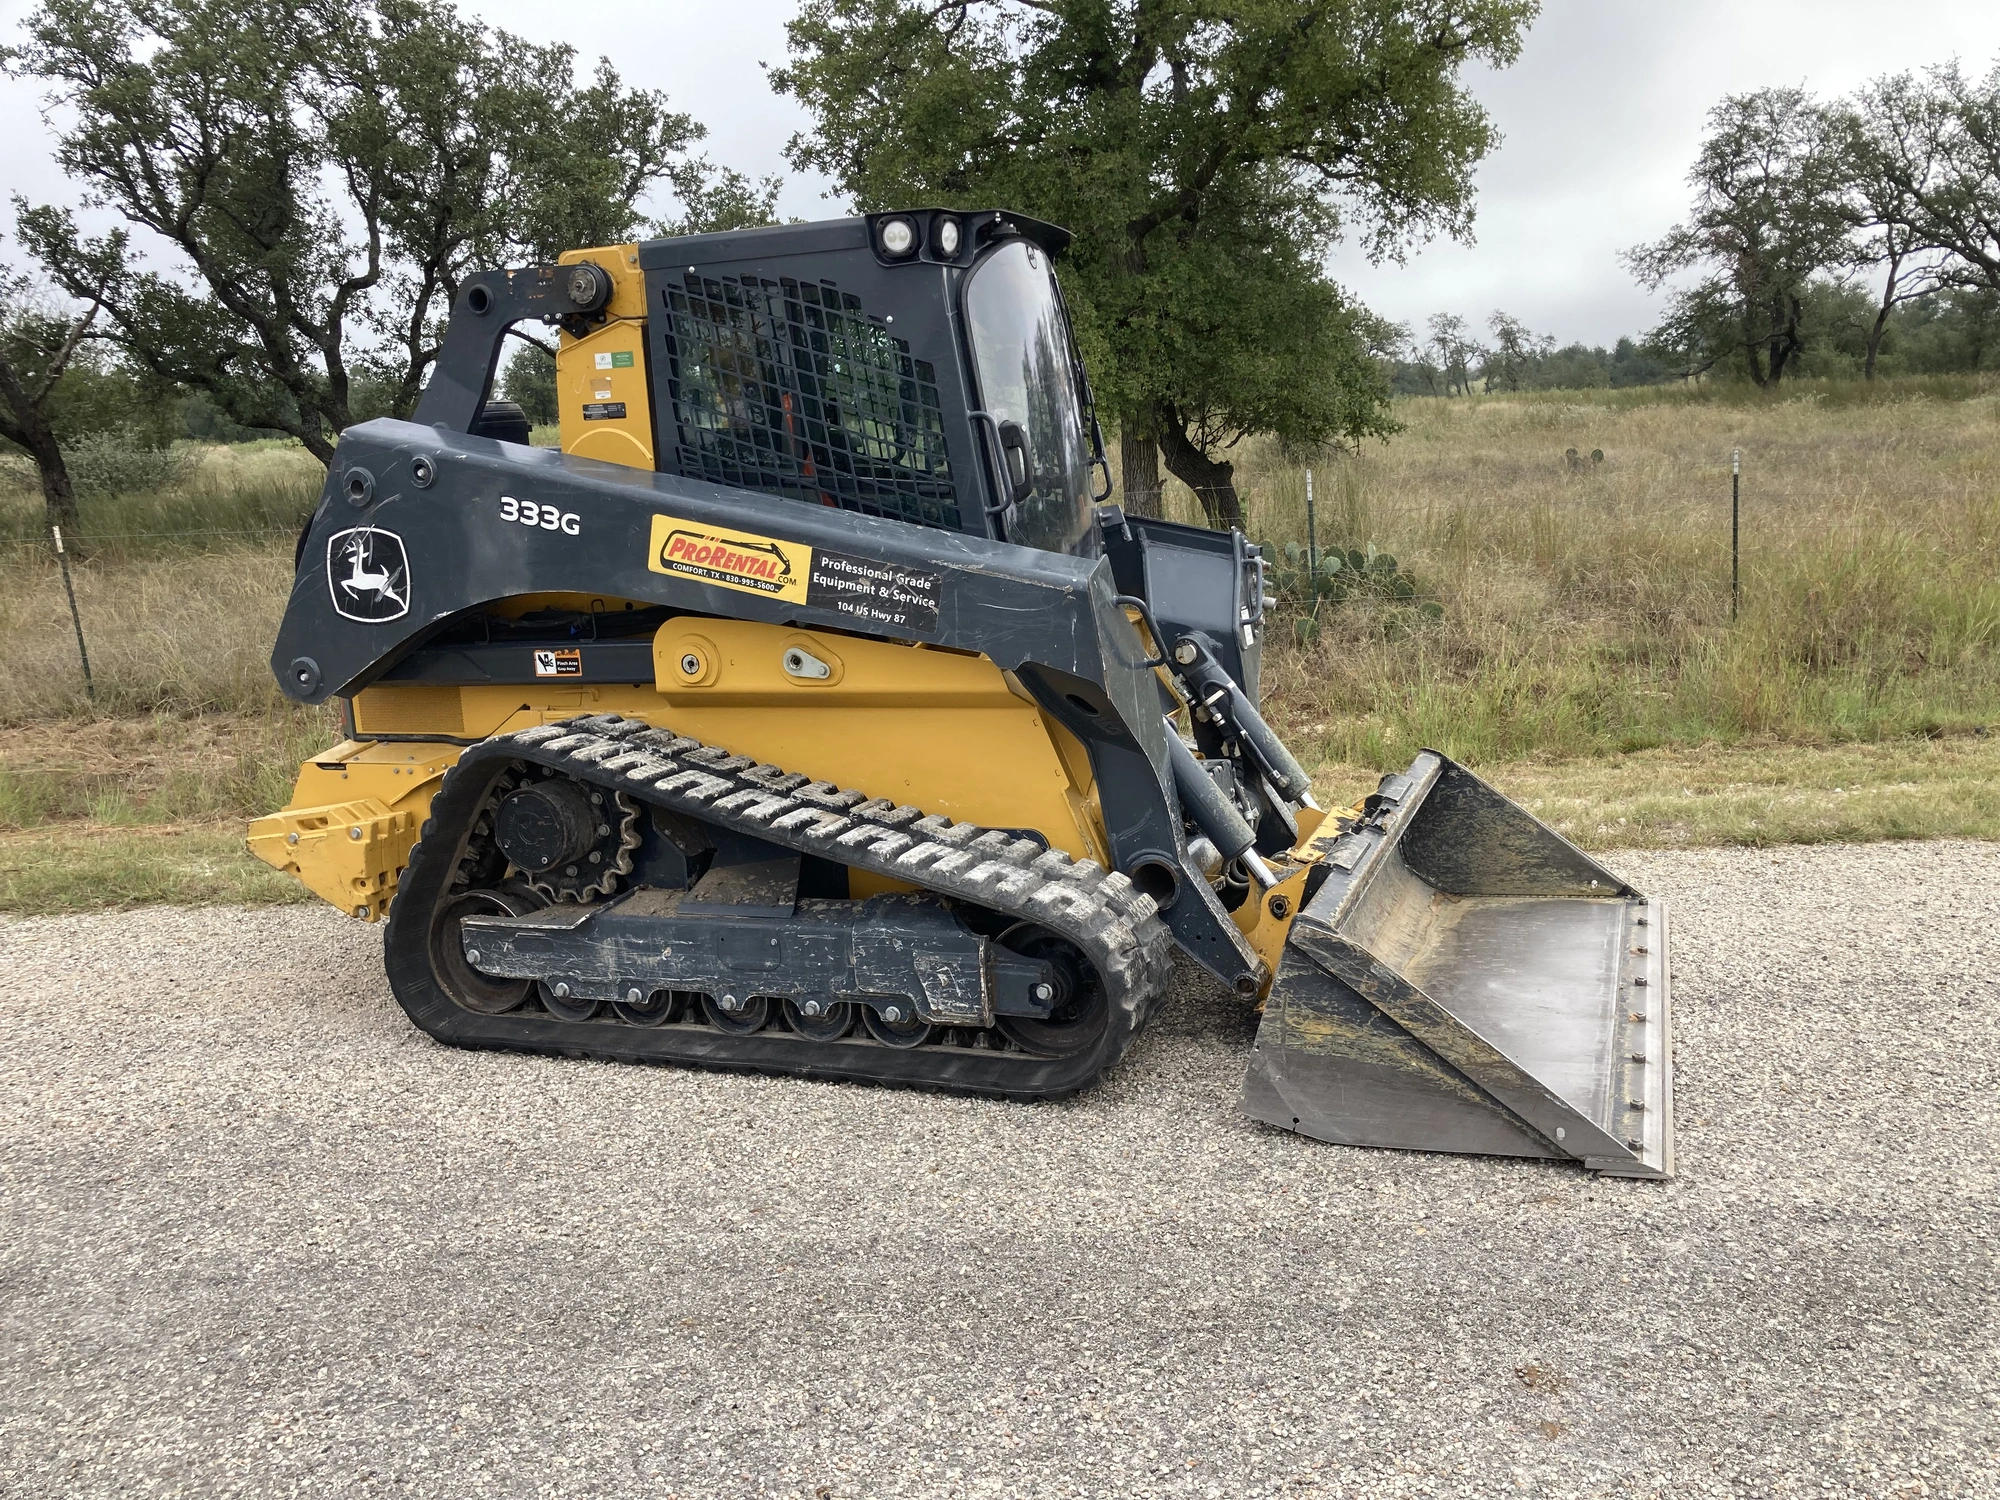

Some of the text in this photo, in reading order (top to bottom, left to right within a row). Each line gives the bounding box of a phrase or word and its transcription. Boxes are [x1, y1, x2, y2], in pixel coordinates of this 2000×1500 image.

[500, 496, 580, 535] 333G
[672, 563, 775, 591] COMFORT, TX 830-995-5600
[813, 572, 935, 608] Equipment & Service
[821, 557, 931, 590] Professional Grade
[837, 601, 906, 623] 104 US Hwy 87
